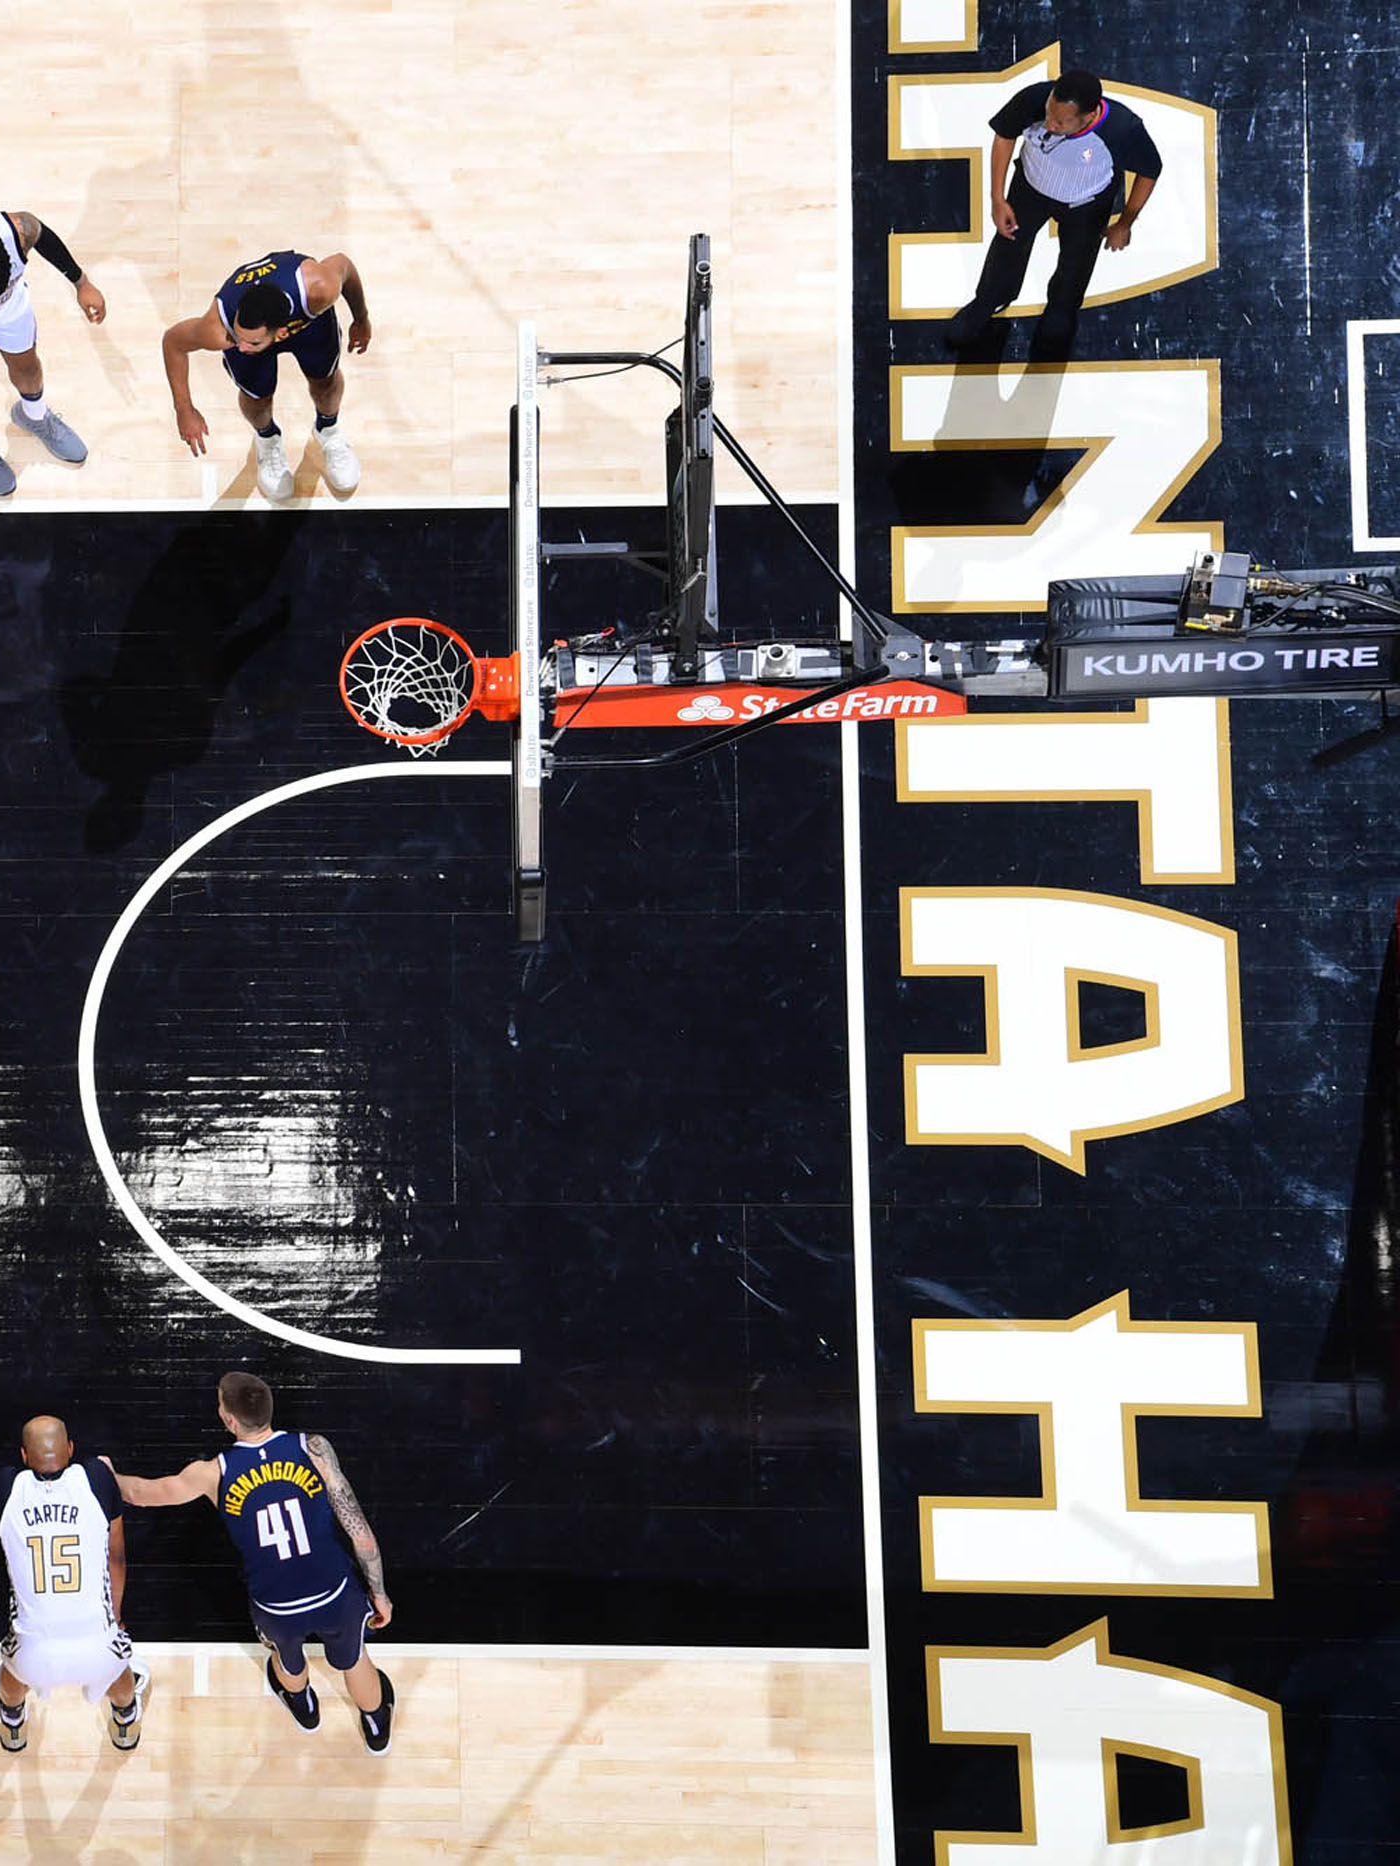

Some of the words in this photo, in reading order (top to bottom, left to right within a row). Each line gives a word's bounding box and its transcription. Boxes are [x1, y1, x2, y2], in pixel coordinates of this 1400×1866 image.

[234, 263, 278, 284] LYLES
[888, 0, 1245, 1177] ANTA
[1083, 650, 1266, 677] KUMHO
[1274, 646, 1380, 670] TIRE
[22, 1503, 79, 1527] CARTER
[224, 1460, 324, 1517] HERNANGOMEZ
[256, 1498, 311, 1561] 41
[26, 1534, 82, 1594] 15
